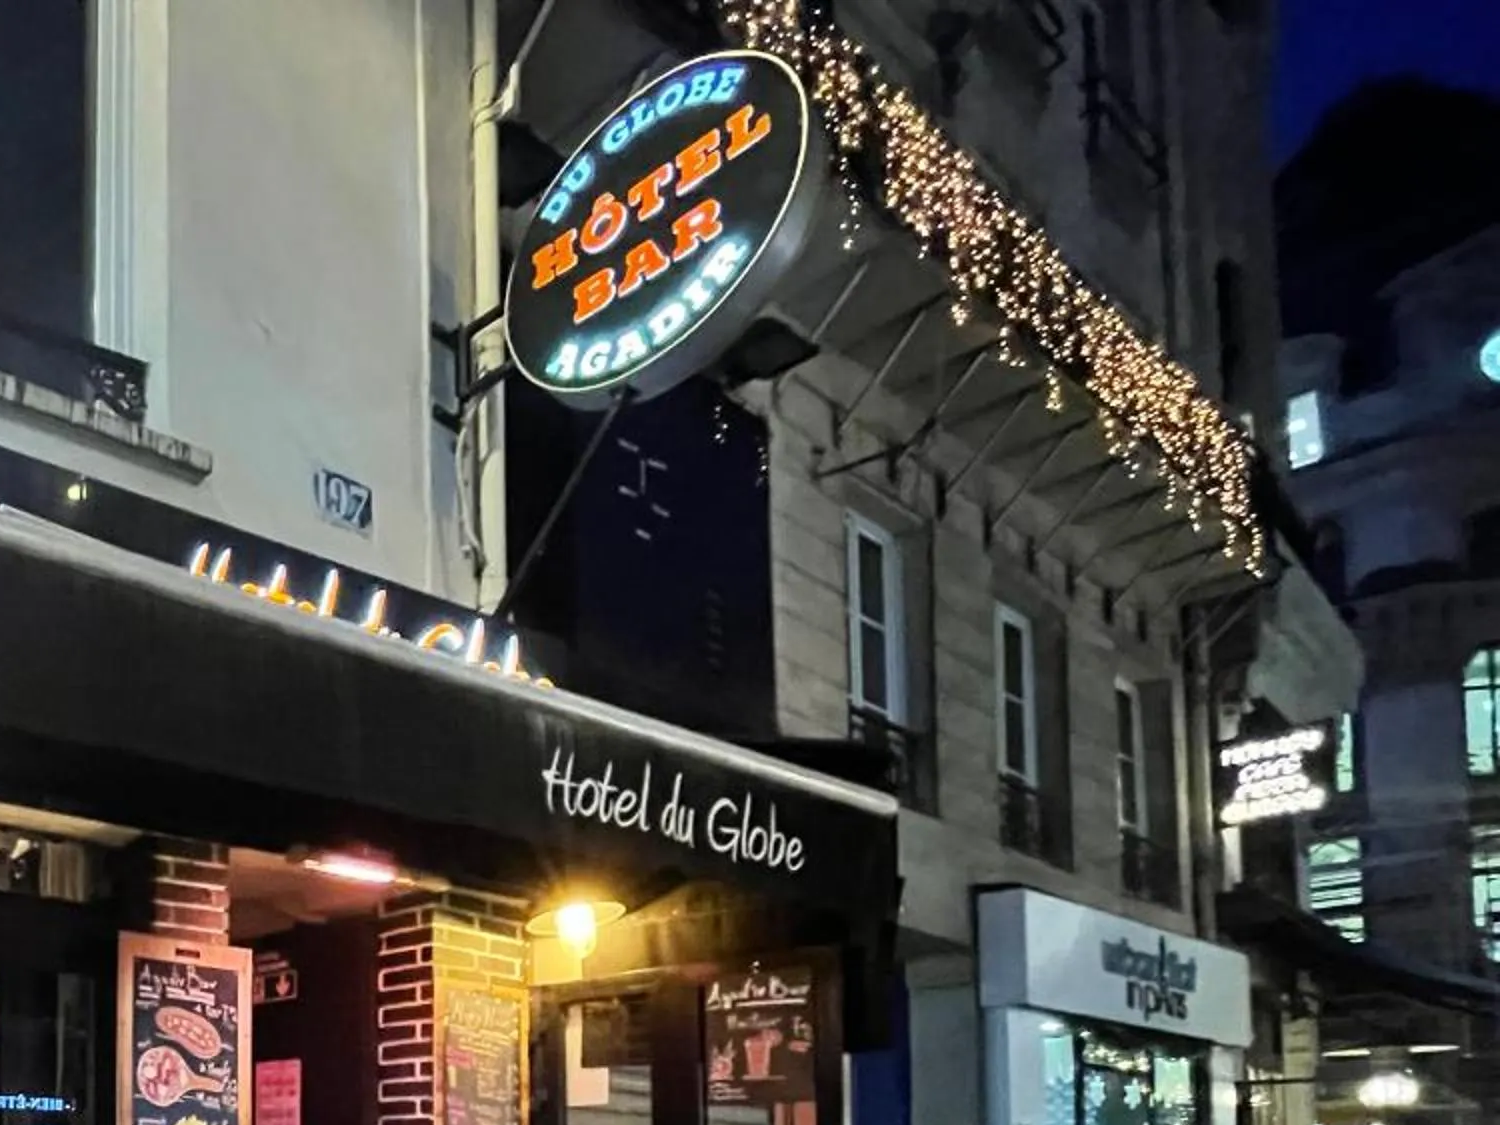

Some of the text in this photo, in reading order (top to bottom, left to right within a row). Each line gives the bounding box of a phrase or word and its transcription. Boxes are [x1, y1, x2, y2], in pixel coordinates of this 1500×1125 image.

[531, 103, 772, 289] HÔTEL
[540, 64, 747, 224] DU GLOBE
[545, 238, 749, 380] AGADIR
[572, 198, 723, 325] BAR
[319, 472, 368, 523] 197
[542, 745, 805, 872] Hotel du Globe
